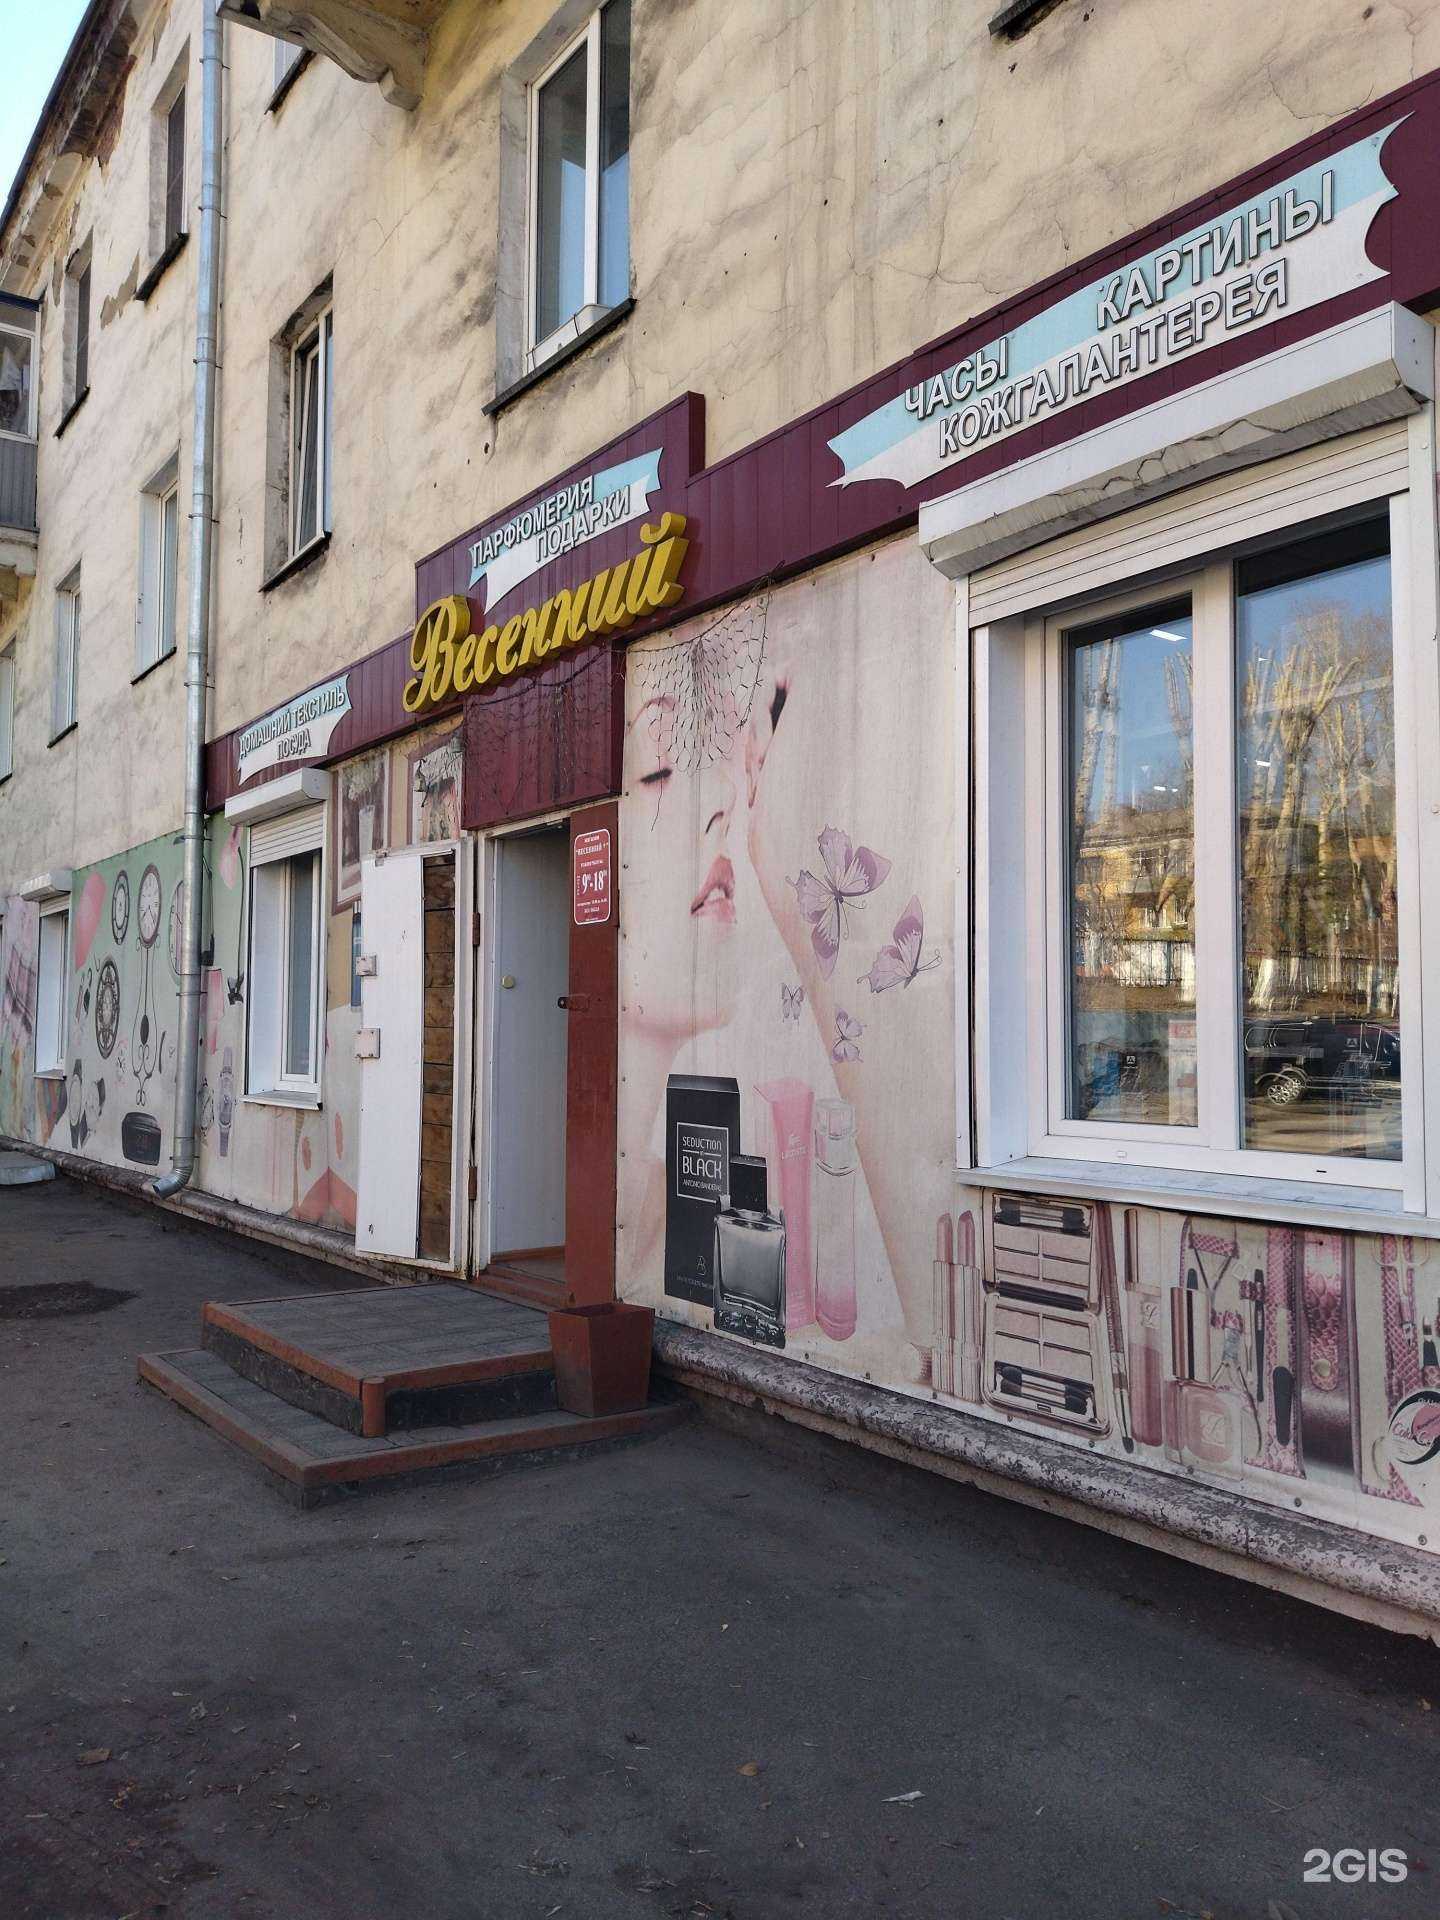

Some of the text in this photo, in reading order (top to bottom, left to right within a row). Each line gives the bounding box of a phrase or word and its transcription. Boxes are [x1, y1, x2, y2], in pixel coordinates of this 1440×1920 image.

[903, 170, 1335, 421] ЧАСЫ КАРТИНЫ
[938, 257, 1287, 458] КОЖГАЛАНТЕРЕЯ
[472, 475, 594, 568] ПАРФЮМЕРИЯ
[536, 485, 631, 562] ПОДАРКИ
[402, 511, 689, 713] Весенний
[239, 685, 346, 759] ДОМАШНИЙ ТЕКСТИЛЬ
[277, 728, 312, 760] ПОСУДА
[682, 1135, 722, 1151] SEDUCTION
[682, 1155, 722, 1180] BLACK
